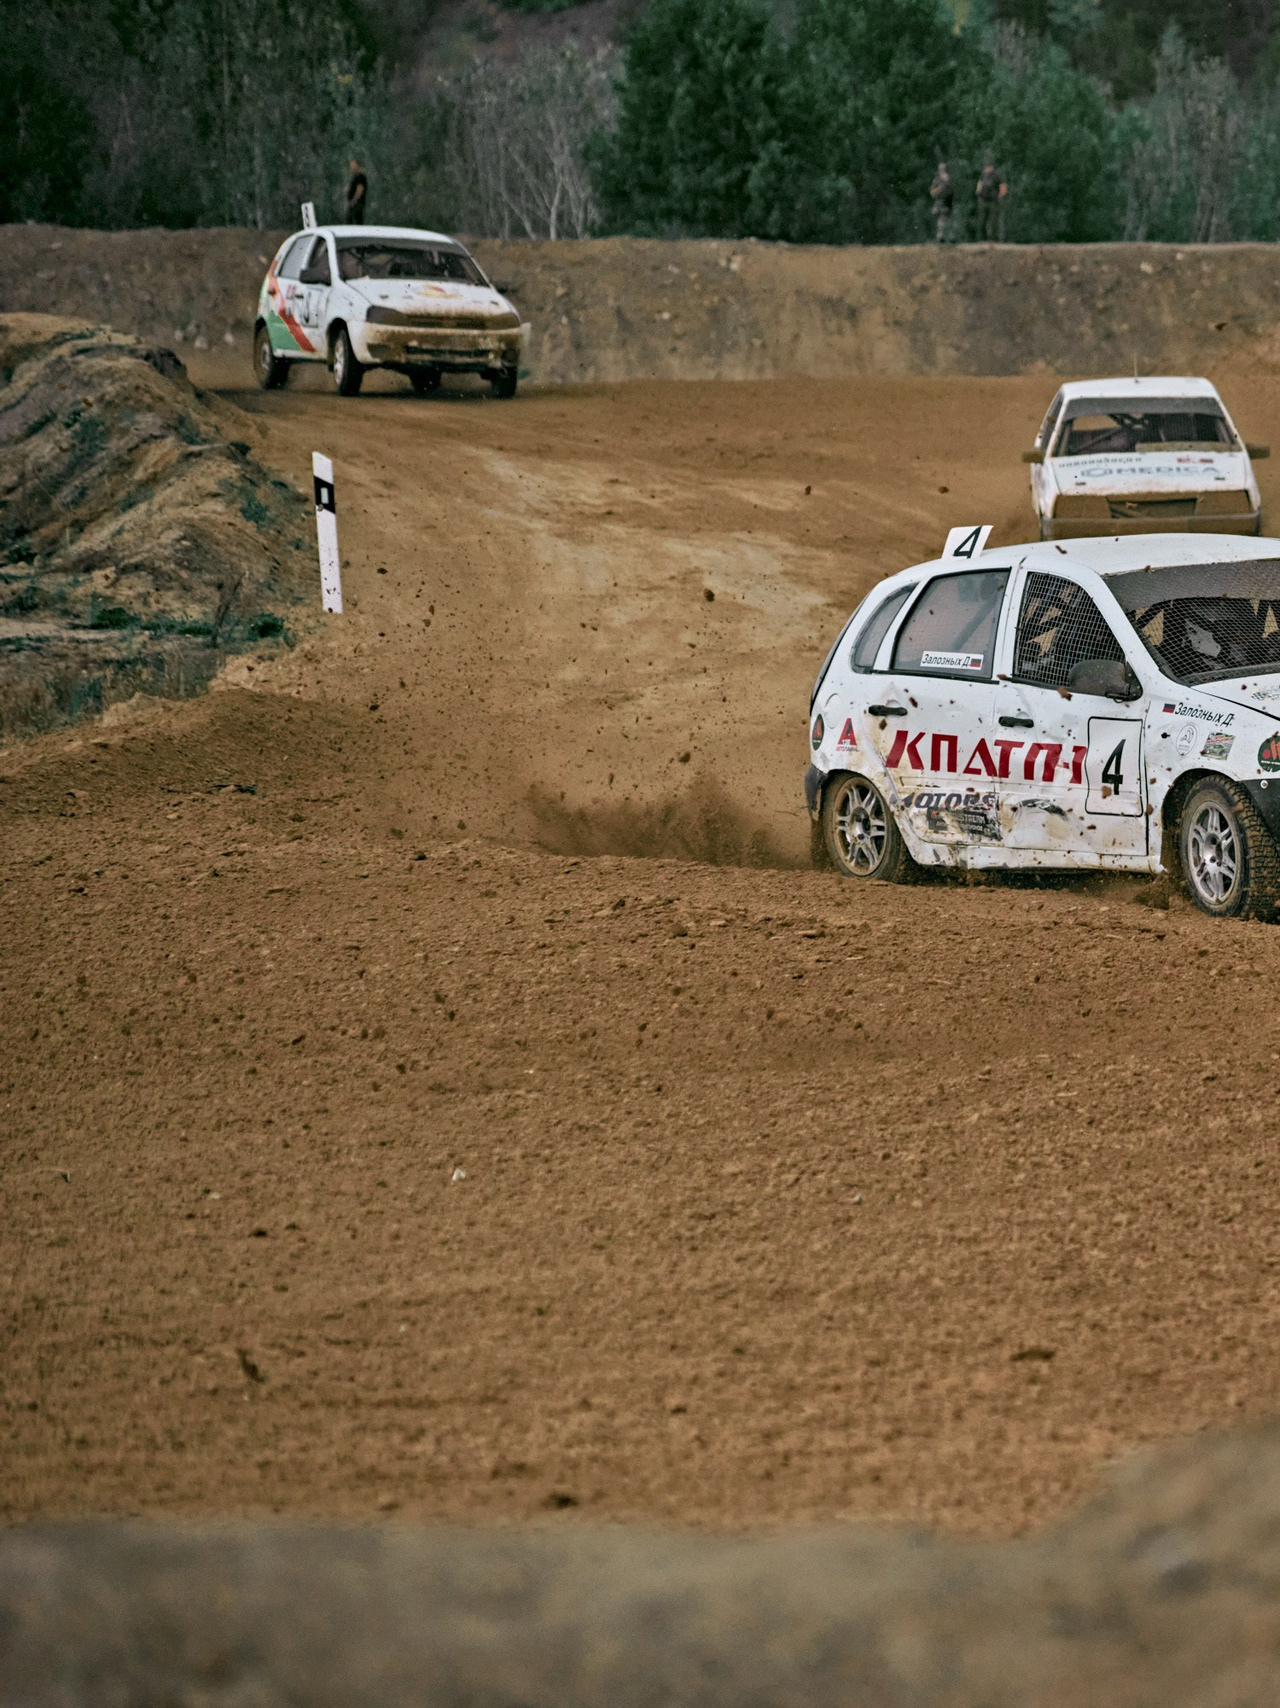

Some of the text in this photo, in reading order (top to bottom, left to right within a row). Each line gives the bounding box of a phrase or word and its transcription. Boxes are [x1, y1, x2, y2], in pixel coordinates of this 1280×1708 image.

[953, 526, 982, 559] 4
[921, 653, 962, 666] Залозных
[1175, 702, 1223, 723] Залозных
[1102, 739, 1126, 795] 4
